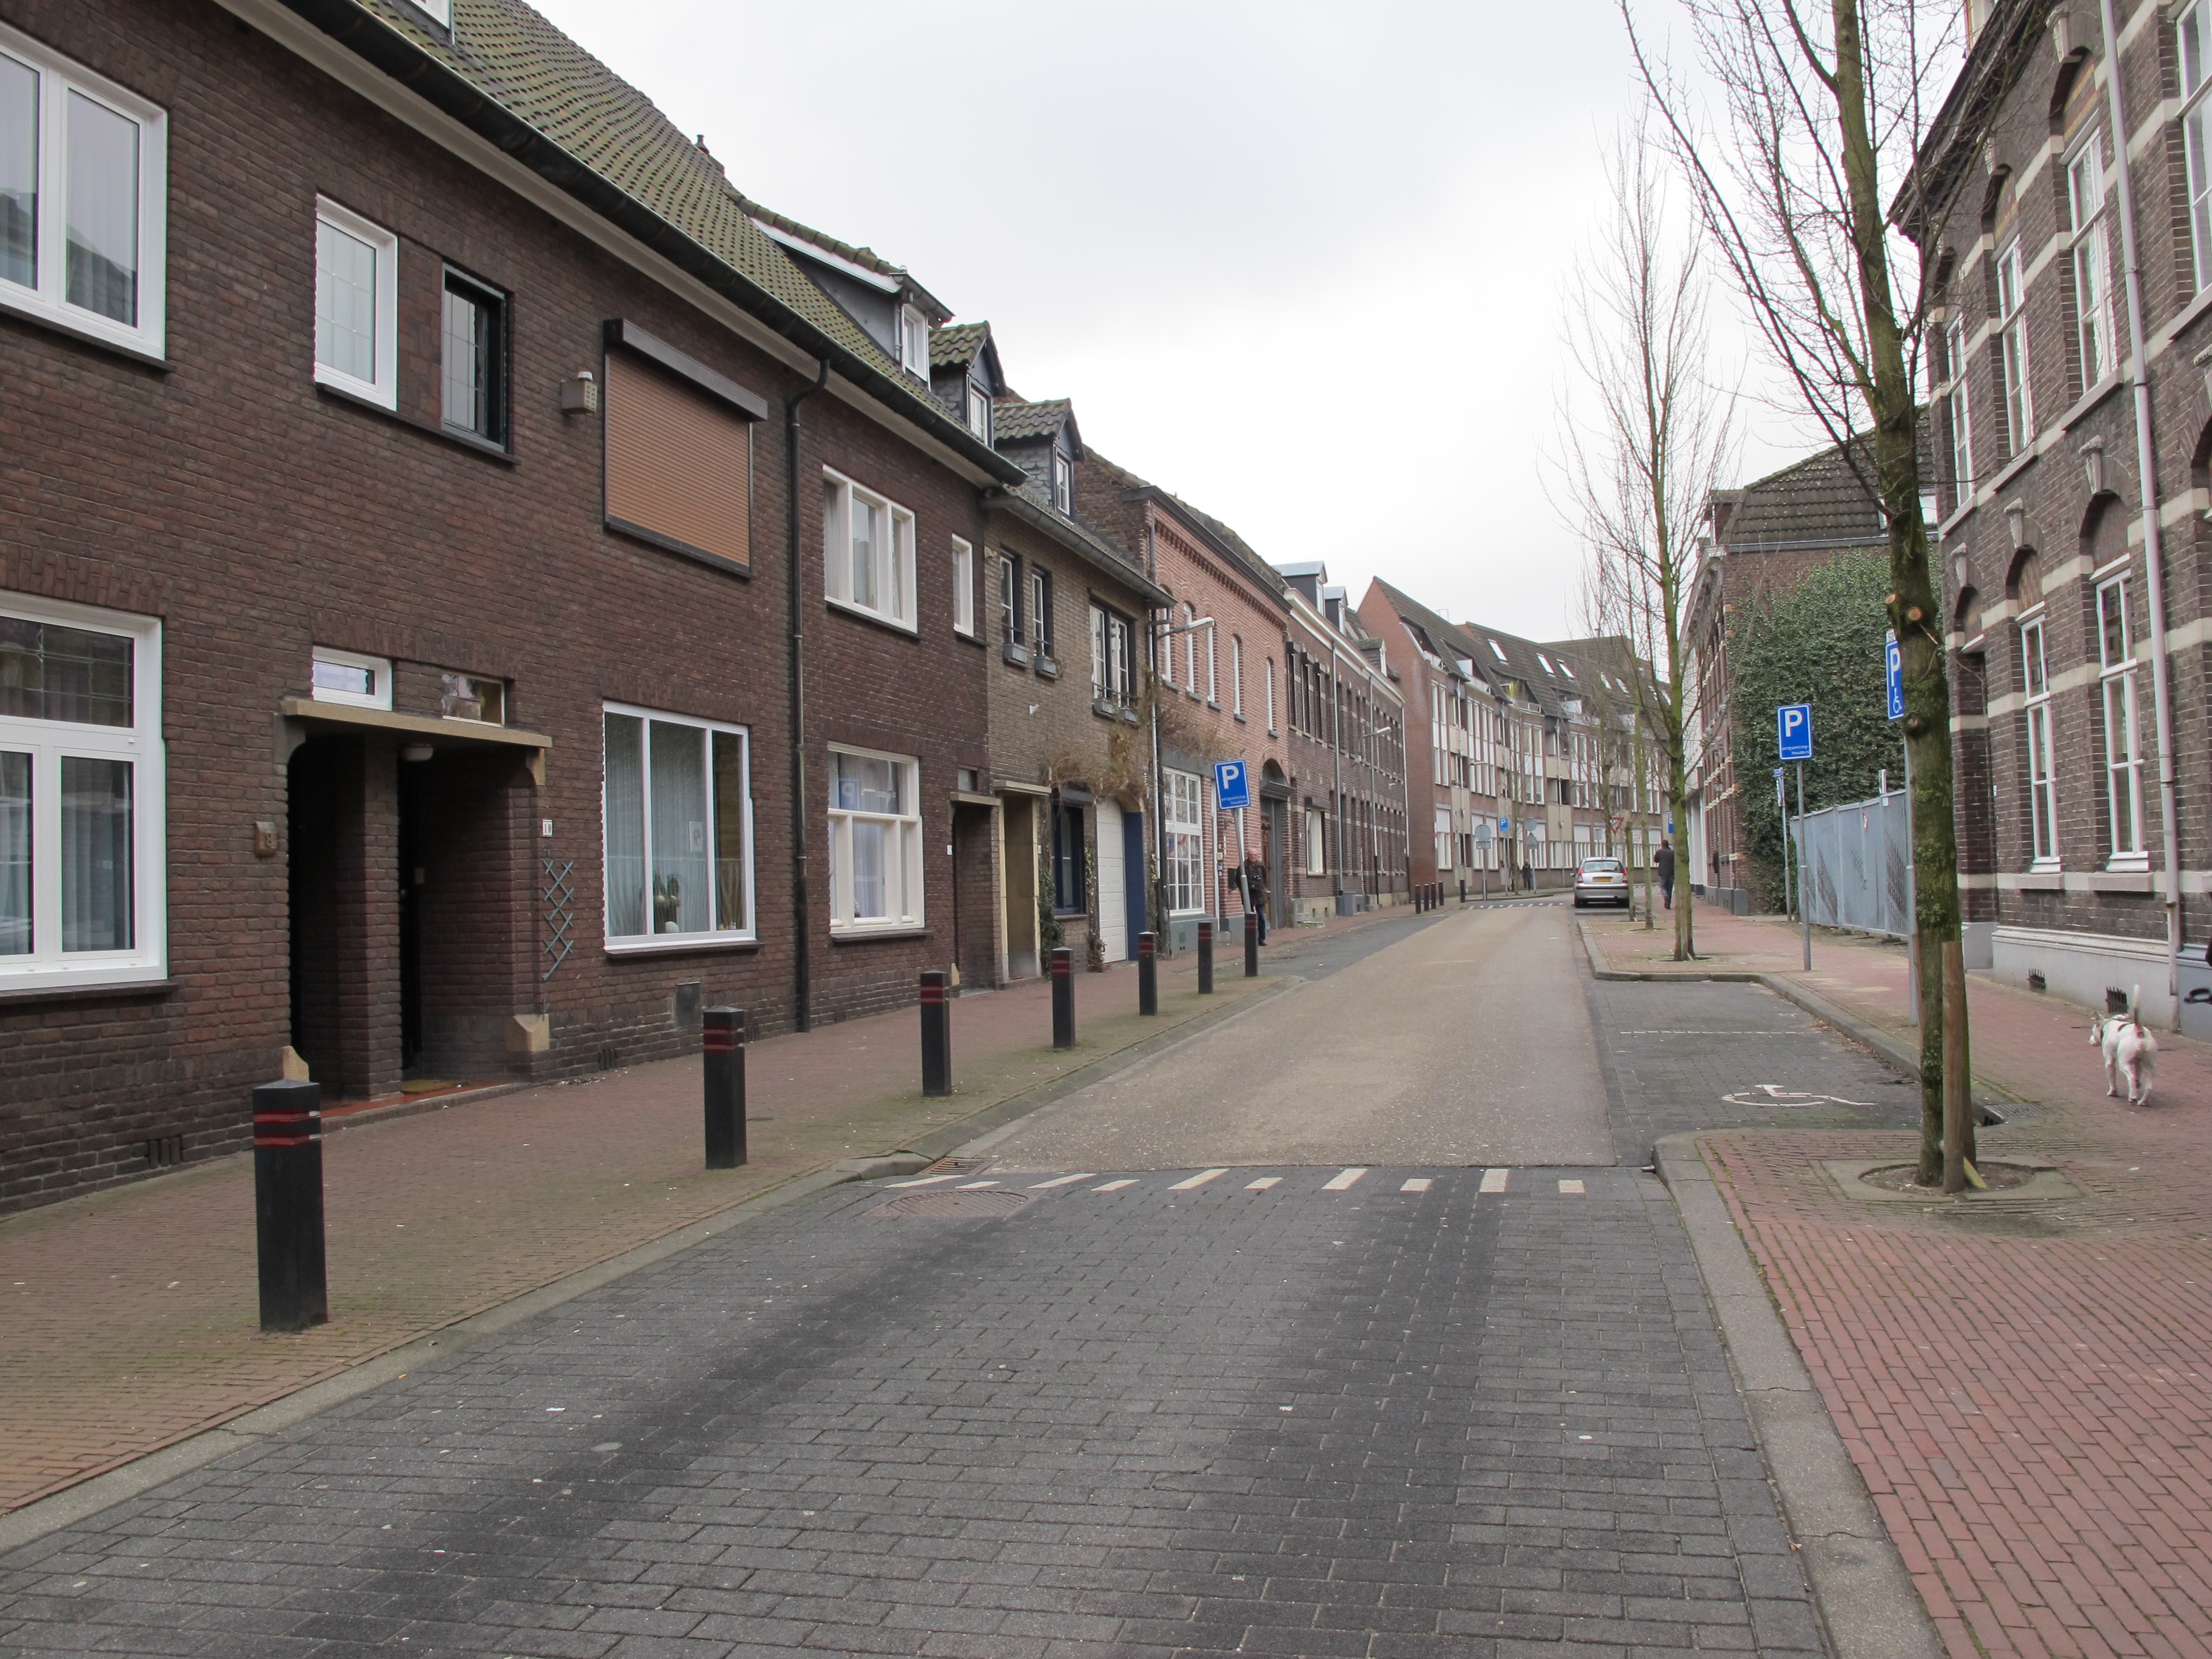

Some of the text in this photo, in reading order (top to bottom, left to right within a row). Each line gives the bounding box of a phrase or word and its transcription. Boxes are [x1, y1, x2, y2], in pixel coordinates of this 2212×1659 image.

[1889, 648, 1901, 687] P
[1785, 709, 1803, 737] P
[1221, 765, 1239, 789] P
